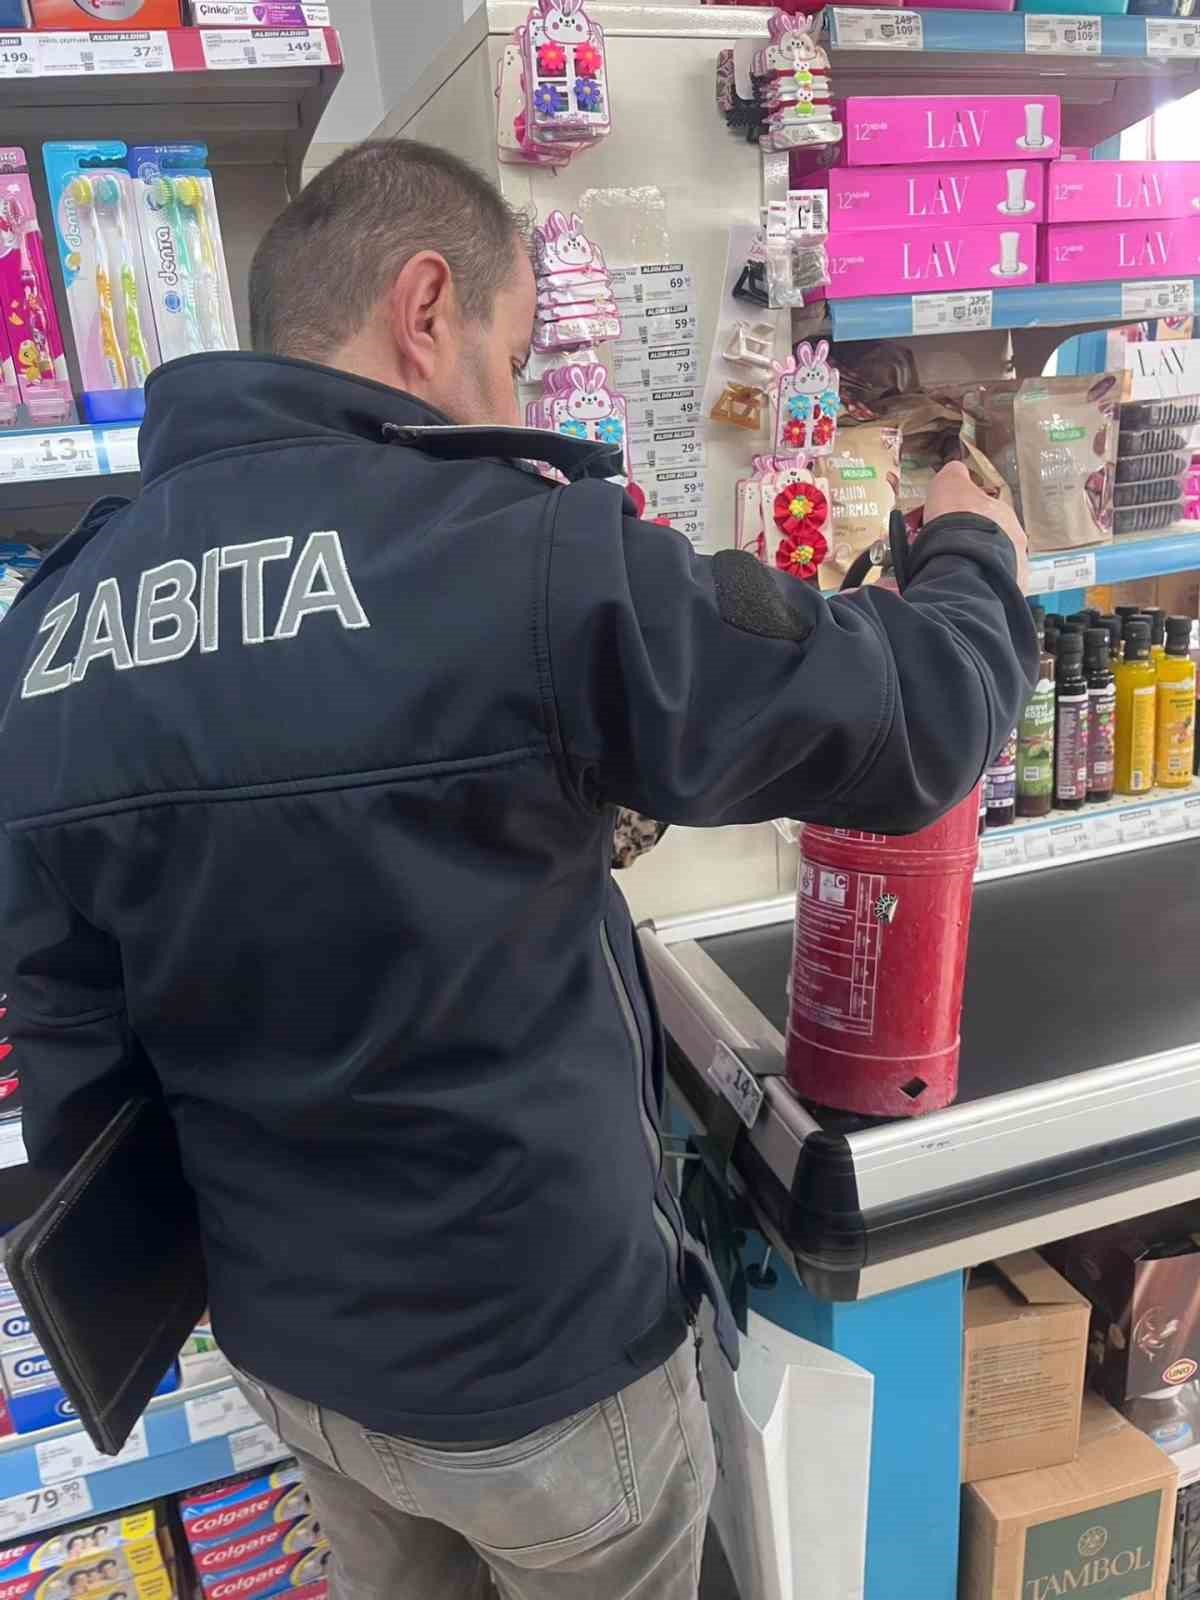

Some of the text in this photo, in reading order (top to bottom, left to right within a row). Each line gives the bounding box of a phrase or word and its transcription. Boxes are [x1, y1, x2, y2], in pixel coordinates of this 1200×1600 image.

[2, 52, 28, 63] 199
[133, 46, 151, 57] 37
[287, 42, 311, 51] 149
[923, 110, 991, 149] LAV
[906, 176, 971, 216] LAV
[1112, 173, 1168, 208] LAV
[156, 227, 178, 286] denta
[901, 240, 963, 280] LAV
[1116, 232, 1173, 267] LAV
[670, 278, 683, 288] 69
[675, 318, 688, 329] 59
[677, 362, 690, 372] 79
[680, 403, 693, 413] 49
[40, 438, 93, 462] 13 TL
[682, 443, 694, 453] 29
[684, 483, 696, 493] 59
[685, 522, 697, 533] 29
[21, 531, 370, 699] ZABITA
[26, 1490, 59, 1515] 79
[191, 1499, 271, 1534] Colgate
[202, 1530, 279, 1566] Colgate
[212, 1563, 288, 1599] Colgate
[1025, 1546, 1151, 1600] TAMBOL
